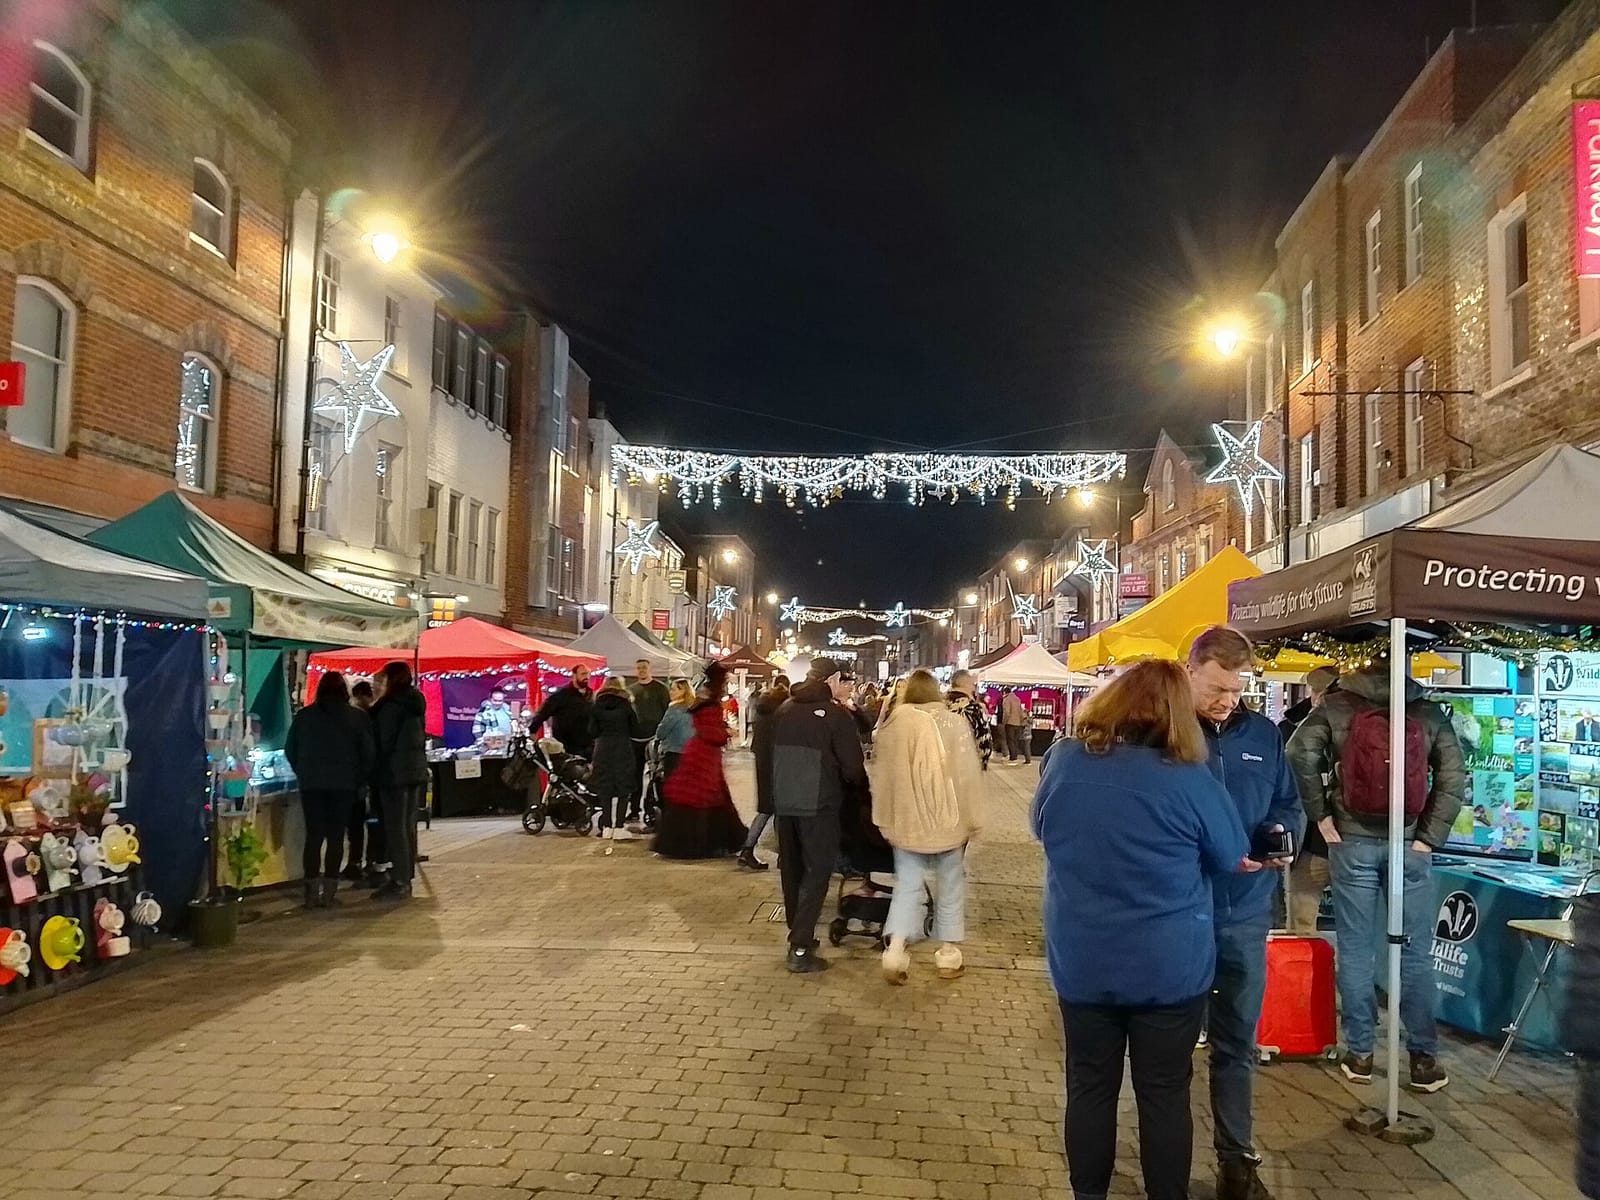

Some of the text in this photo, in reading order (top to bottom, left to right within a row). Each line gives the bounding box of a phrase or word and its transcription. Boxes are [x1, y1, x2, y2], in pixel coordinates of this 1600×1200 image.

[1121, 585, 1146, 593] TO LET
[1423, 559, 1586, 601] Protecting
[1230, 582, 1344, 623] Protecting wildlife for the future
[428, 619, 457, 628] GREG
[1428, 939, 1469, 965] ldlife
[1433, 957, 1465, 979] Trusts
